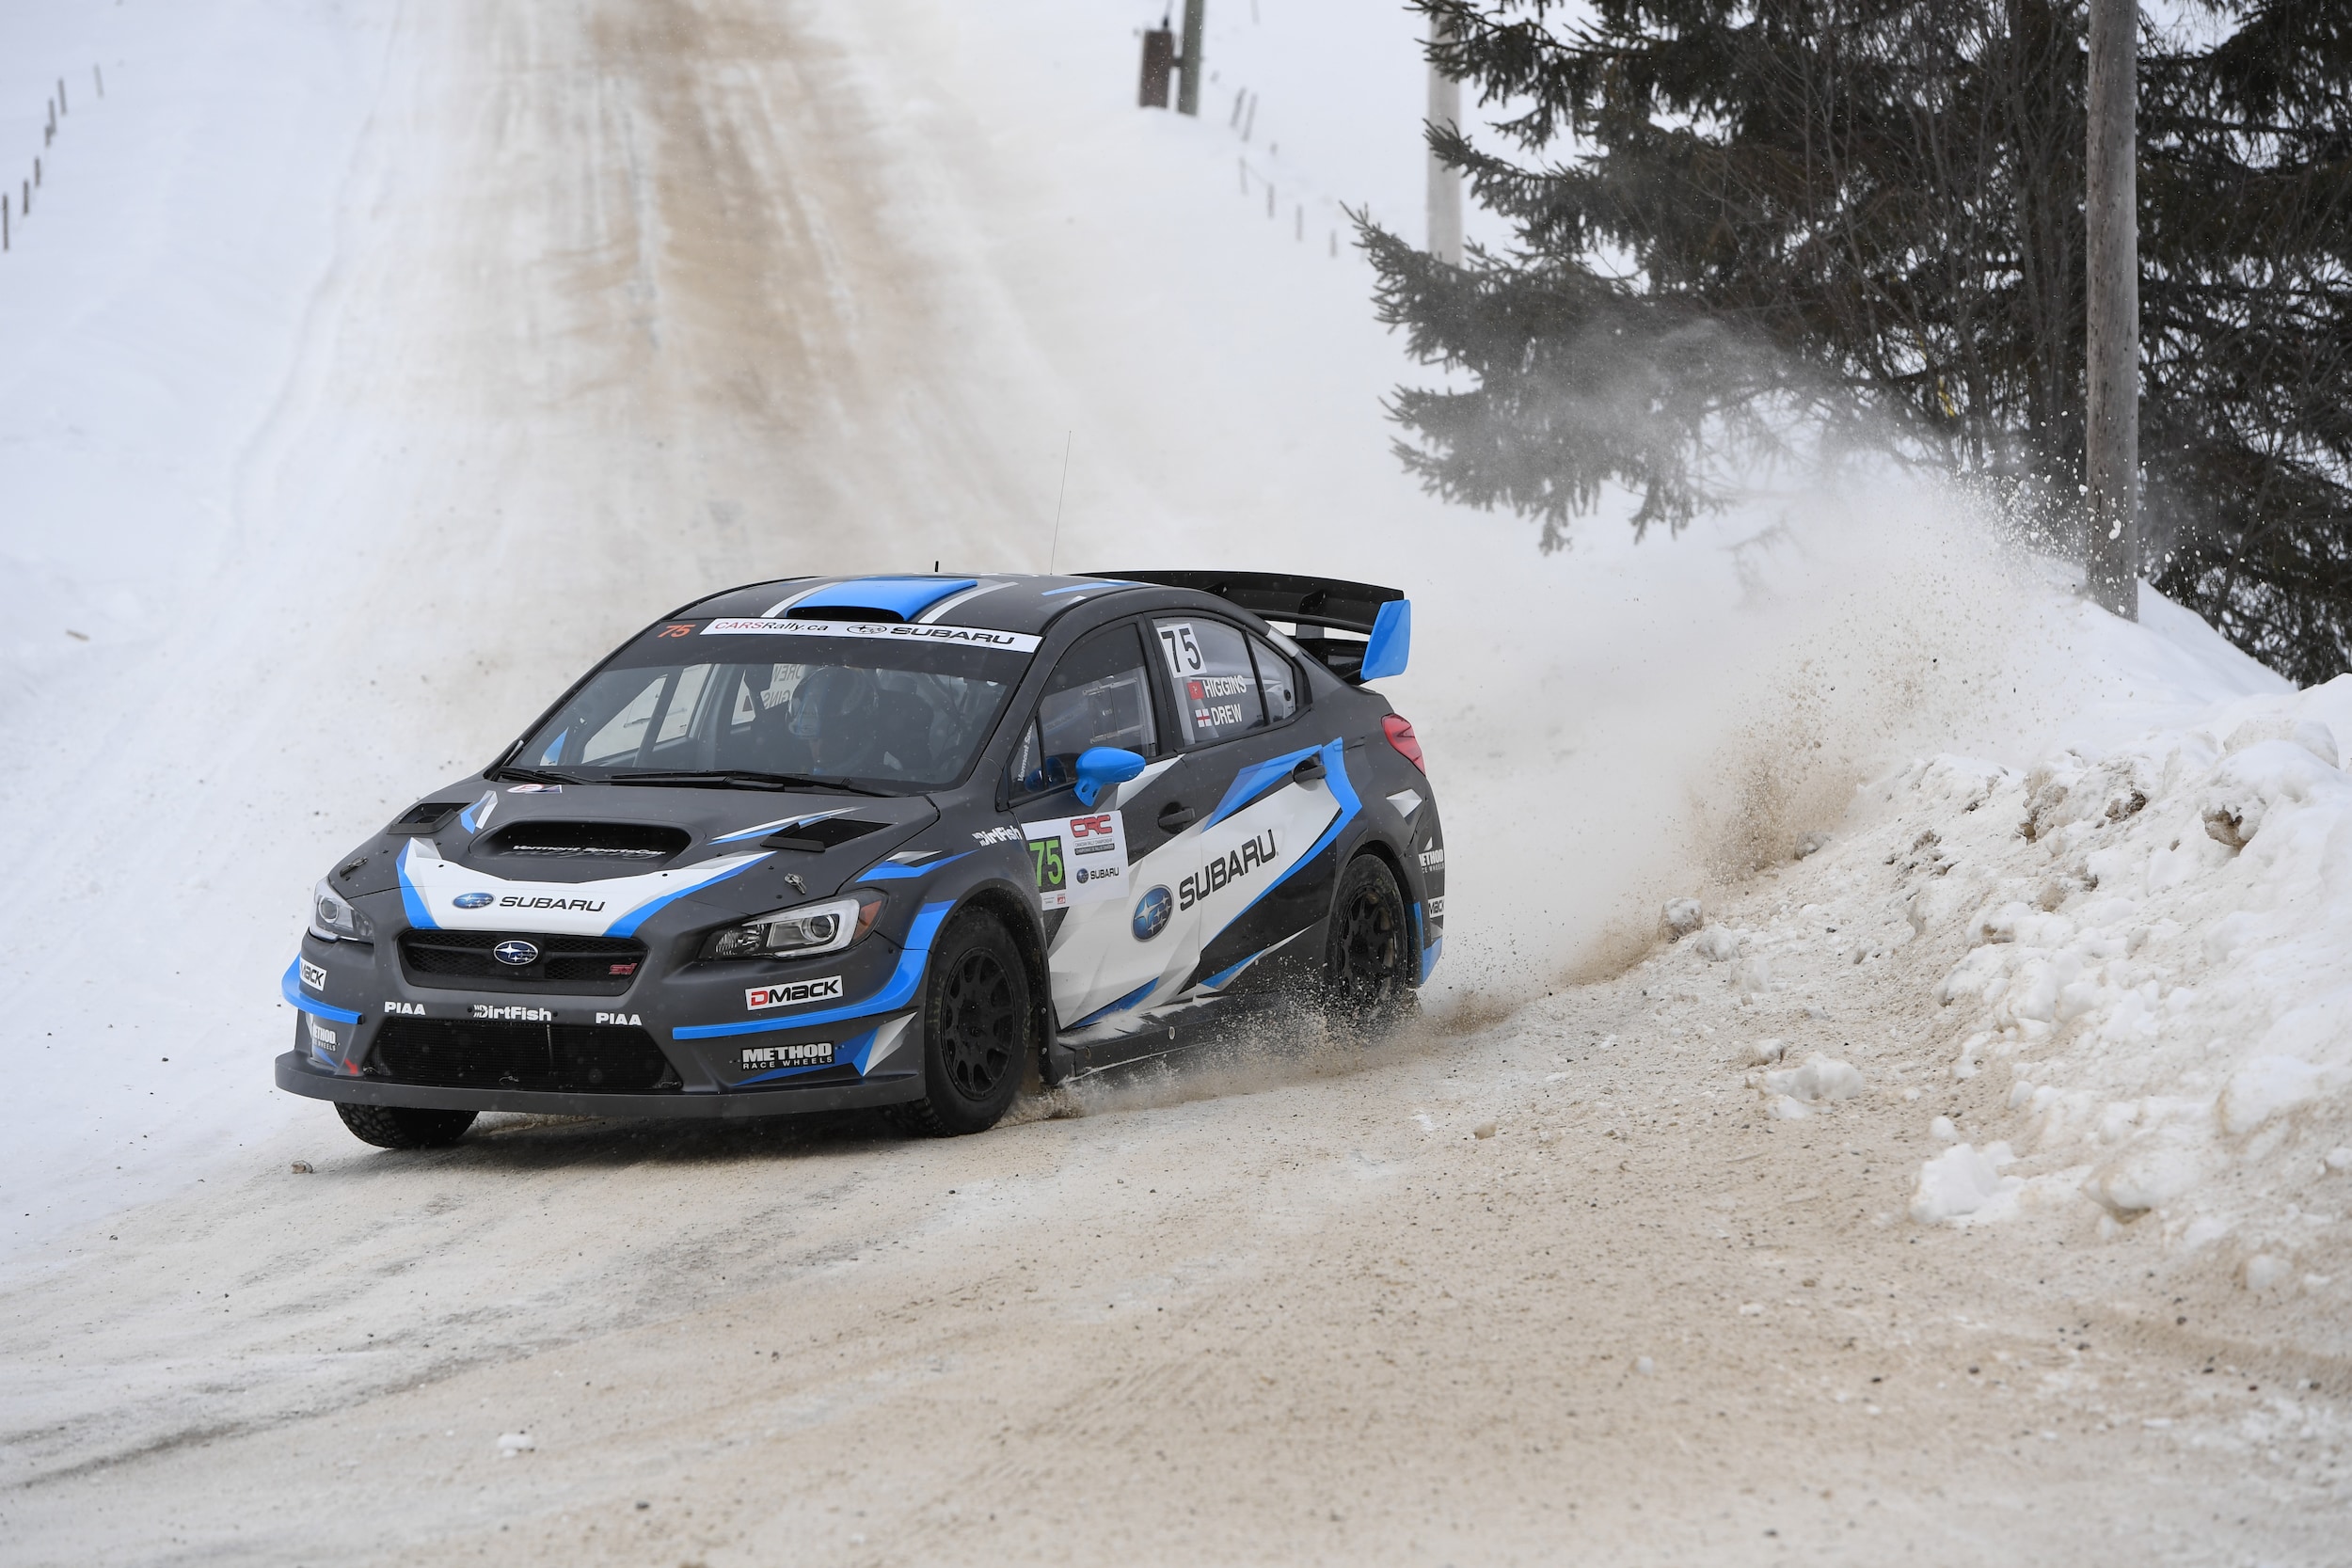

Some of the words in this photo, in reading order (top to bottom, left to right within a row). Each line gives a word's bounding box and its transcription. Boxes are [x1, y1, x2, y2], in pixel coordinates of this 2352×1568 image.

[658, 625, 696, 638] 75
[714, 622, 829, 632] CARSRally.ca
[890, 626, 1015, 645] SUBARU
[1160, 627, 1201, 673] 75
[1202, 674, 1247, 698] HIGGINS
[1210, 704, 1243, 726] DREW
[1017, 744, 1030, 782] Vermont
[972, 825, 1022, 847] DirtFish
[1029, 839, 1063, 887] 75
[1179, 829, 1277, 911] SUBARU
[1089, 867, 1120, 880] SUBARU
[499, 895, 605, 912] SUBARU
[384, 1001, 426, 1016] PIAA
[472, 1004, 552, 1022] DirtFish
[596, 1012, 642, 1026] PIAA
[742, 1042, 833, 1063] METHOD
[743, 1060, 776, 1070] RACE
[783, 1055, 833, 1068] WHEELS
